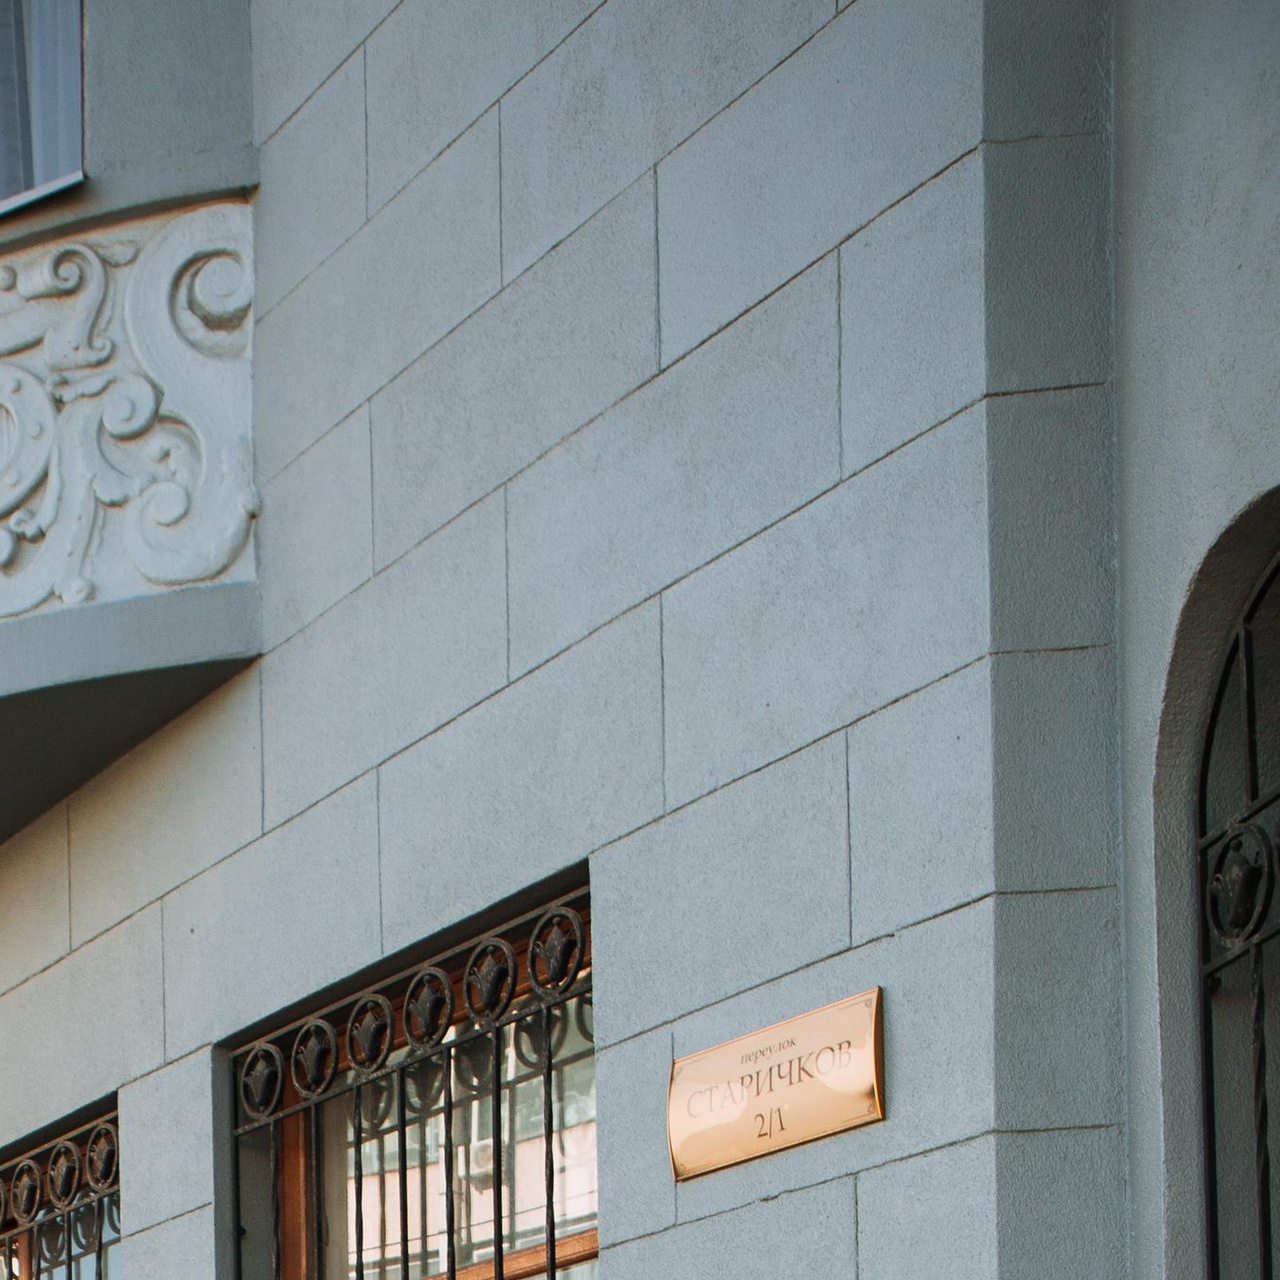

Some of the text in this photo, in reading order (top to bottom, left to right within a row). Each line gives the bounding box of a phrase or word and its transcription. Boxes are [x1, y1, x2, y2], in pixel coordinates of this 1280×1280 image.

[740, 1038, 796, 1065] переулок
[687, 1040, 853, 1118] СТАРИЧКОВ
[754, 1108, 786, 1139] 2/1
